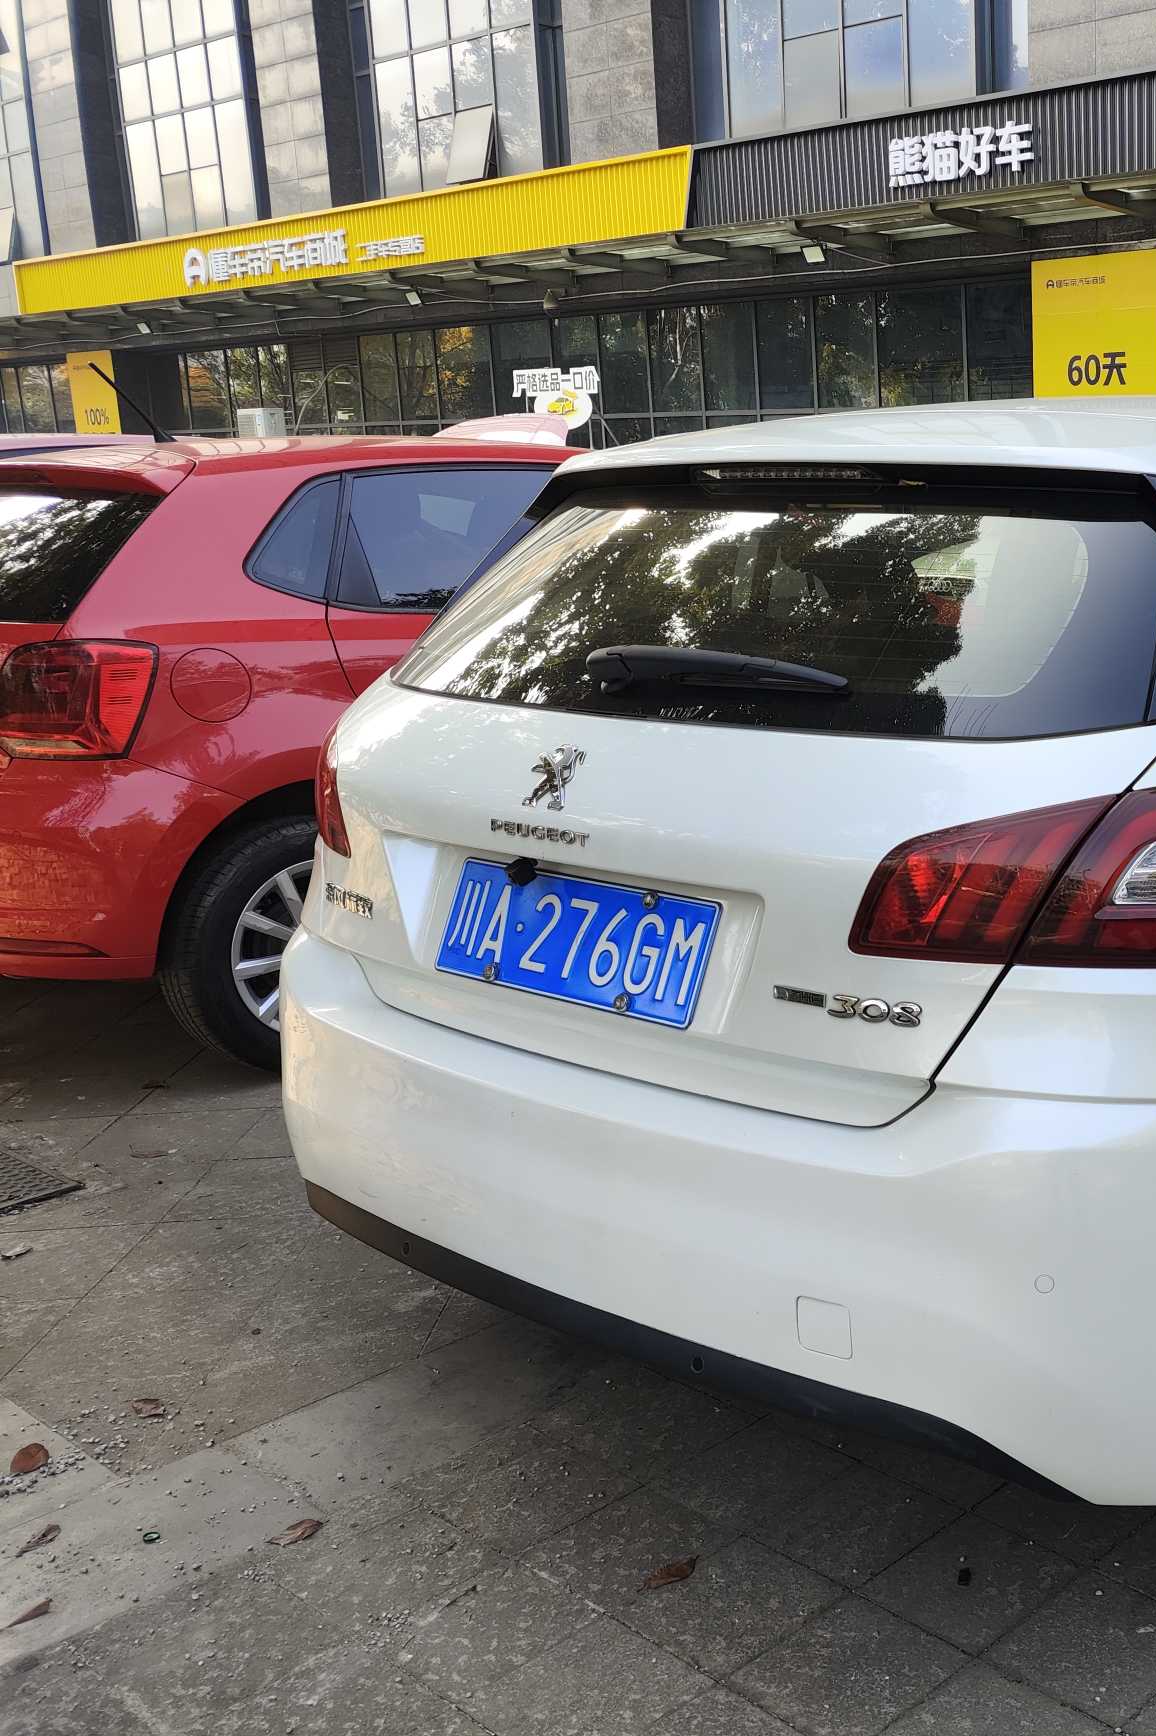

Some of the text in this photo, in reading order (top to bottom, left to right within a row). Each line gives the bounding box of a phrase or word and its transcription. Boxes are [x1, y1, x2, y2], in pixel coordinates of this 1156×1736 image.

[889, 120, 1035, 188] 熊猫好车
[209, 228, 350, 282] 懂车帝汽车商城
[515, 369, 595, 393] 严格选品一口价
[1067, 351, 1127, 387] 60天
[84, 407, 111, 426] 100%
[490, 818, 590, 848] PEUGEOT
[827, 994, 923, 1028] 308
